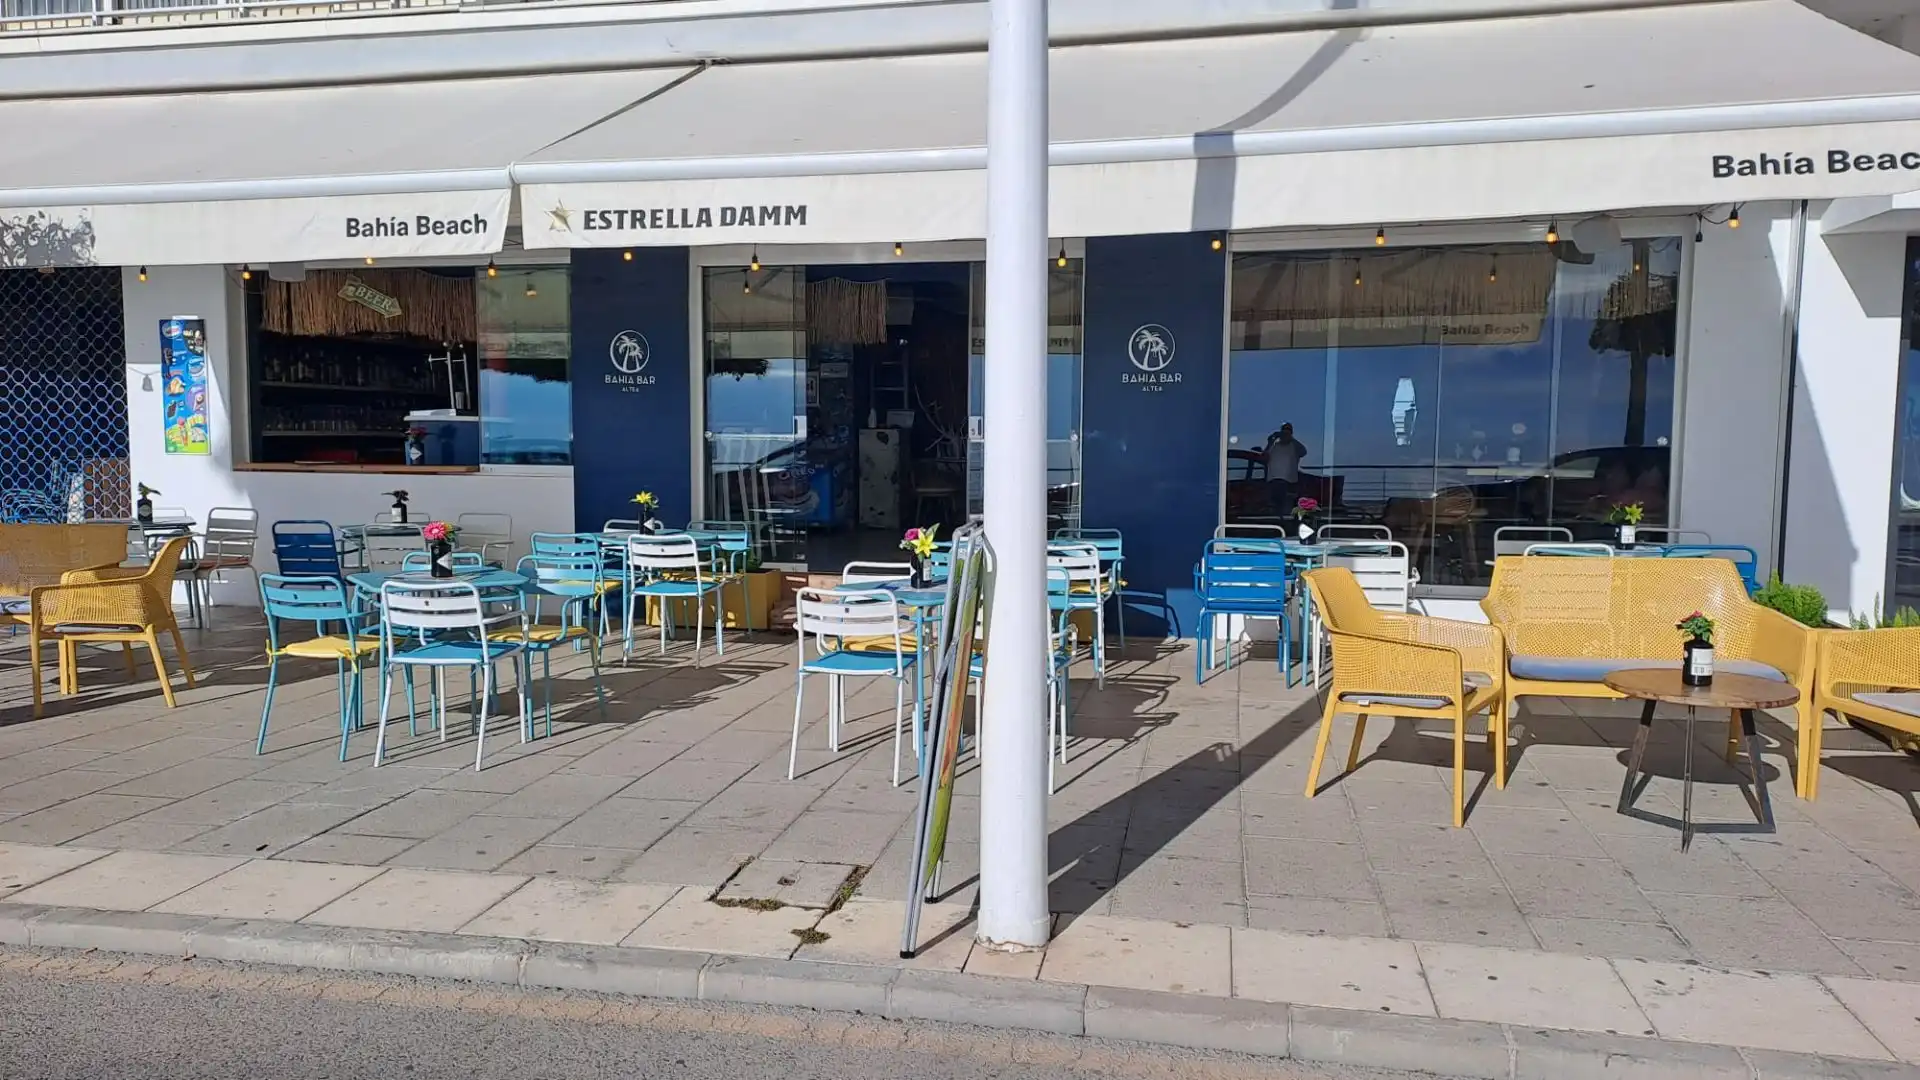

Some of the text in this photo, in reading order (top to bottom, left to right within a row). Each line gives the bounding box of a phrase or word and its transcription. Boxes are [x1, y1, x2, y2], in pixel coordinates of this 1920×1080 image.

[1712, 151, 1815, 178] Bahía
[345, 213, 487, 237] Bahía Beach
[583, 204, 807, 230] ESTRELLA DAMM
[355, 286, 392, 310] BEER
[604, 374, 656, 385] BAHIA BAR
[1122, 372, 1182, 383] BAHIA BAR
